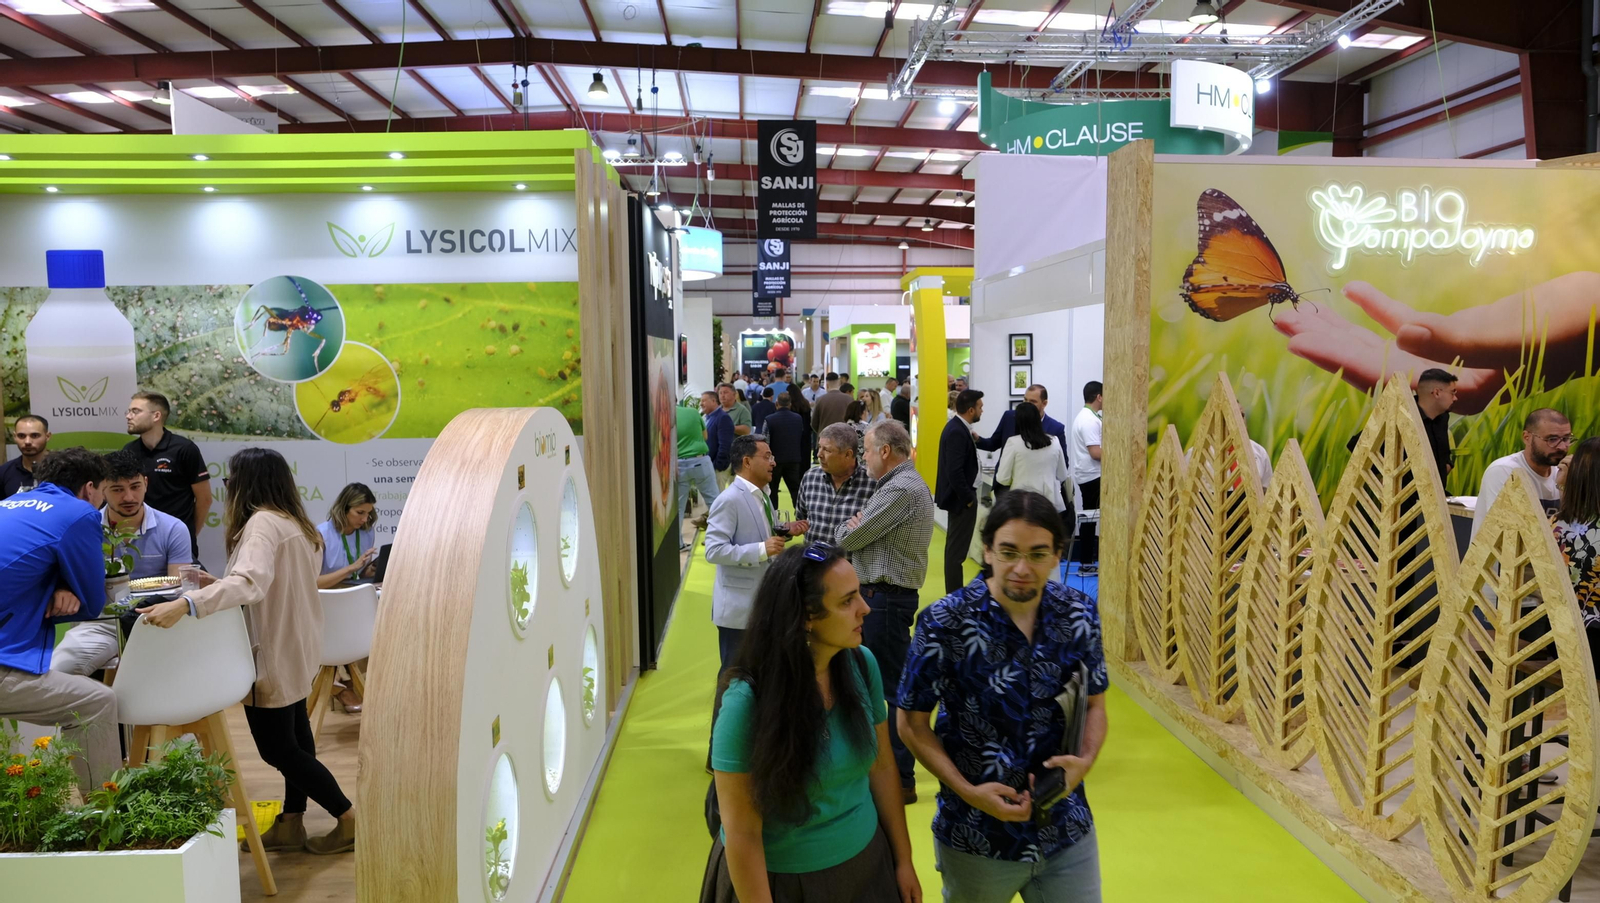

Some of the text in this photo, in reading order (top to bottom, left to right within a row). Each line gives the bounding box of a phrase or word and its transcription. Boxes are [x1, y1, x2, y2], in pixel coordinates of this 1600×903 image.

[1196, 83, 1230, 109] HM
[1006, 122, 1144, 154] HM CLAUSE
[761, 176, 814, 190] SANJI
[405, 228, 578, 254] LYSICOLMIX
[759, 262, 790, 270] SANJI
[52, 406, 119, 417] LYSICOLMIX
[372, 458, 384, 467] Se
[374, 476, 393, 484] una
[376, 524, 388, 533] de
